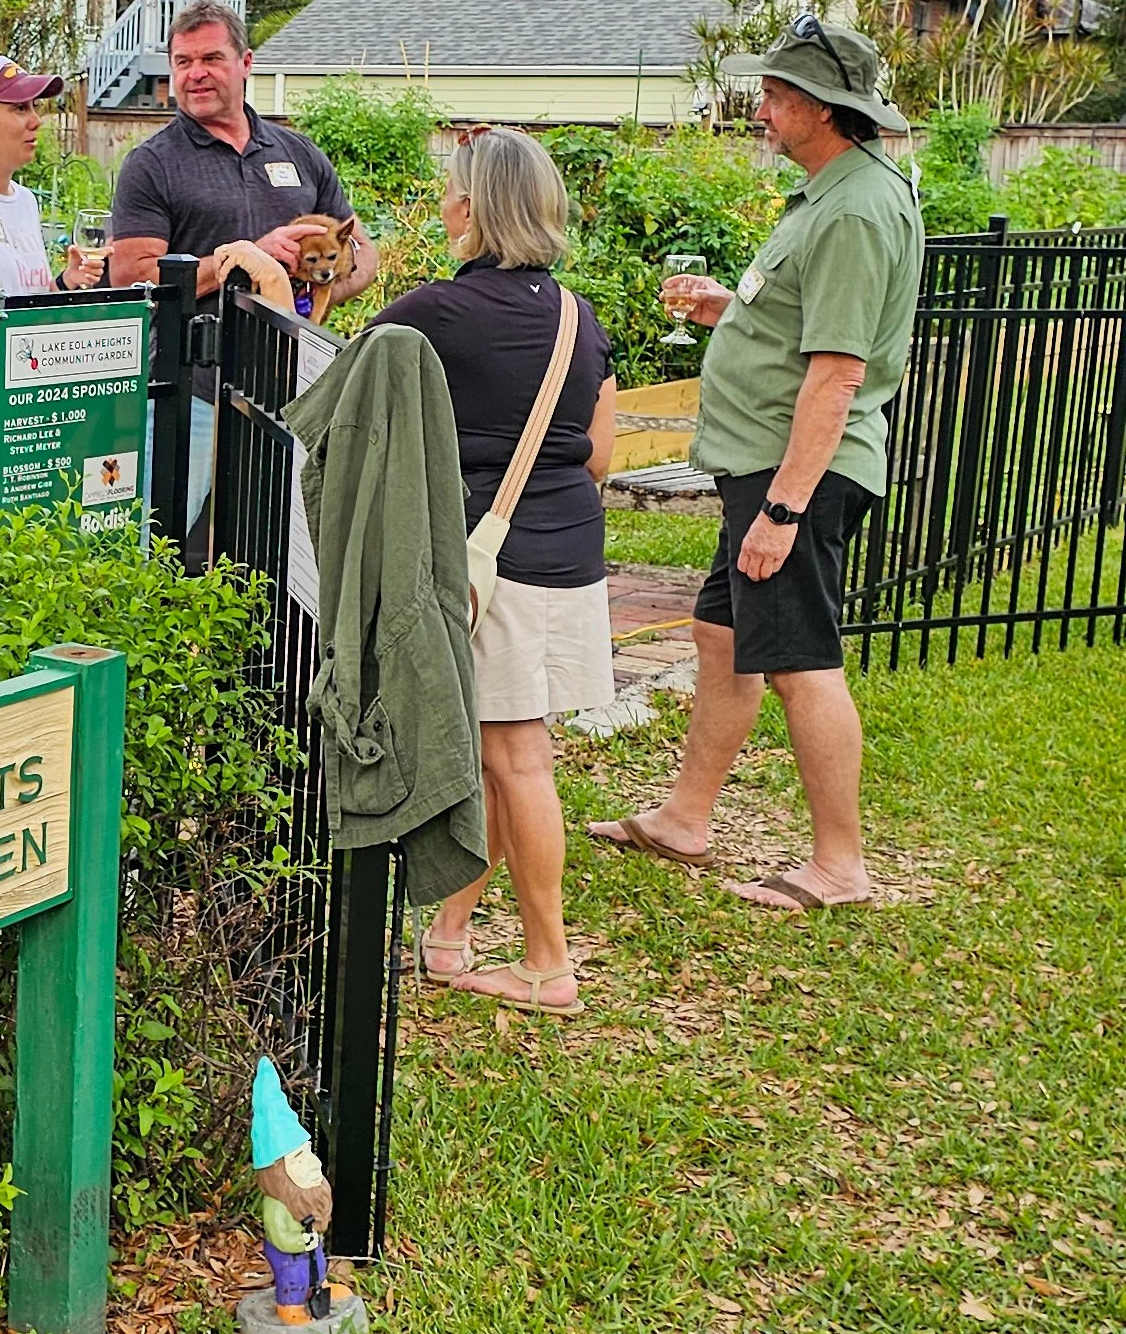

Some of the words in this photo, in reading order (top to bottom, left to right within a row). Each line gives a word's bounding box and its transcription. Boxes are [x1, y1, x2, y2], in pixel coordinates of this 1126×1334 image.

[42, 342, 66, 353] LAKE
[69, 340, 92, 351] EOLA
[95, 336, 132, 347] HEIGHTS
[41, 354, 95, 367] COMMUNITY
[98, 350, 133, 362] GARDEN
[8, 392, 34, 406] OUR
[36, 387, 69, 403] 2024
[72, 379, 138, 398] SPONSORS
[4, 415, 44, 428] HARVEST
[51, 411, 58, 423] $
[3, 462, 41, 475] BLOSSOM
[47, 458, 53, 468] $
[55, 456, 72, 467] 500
